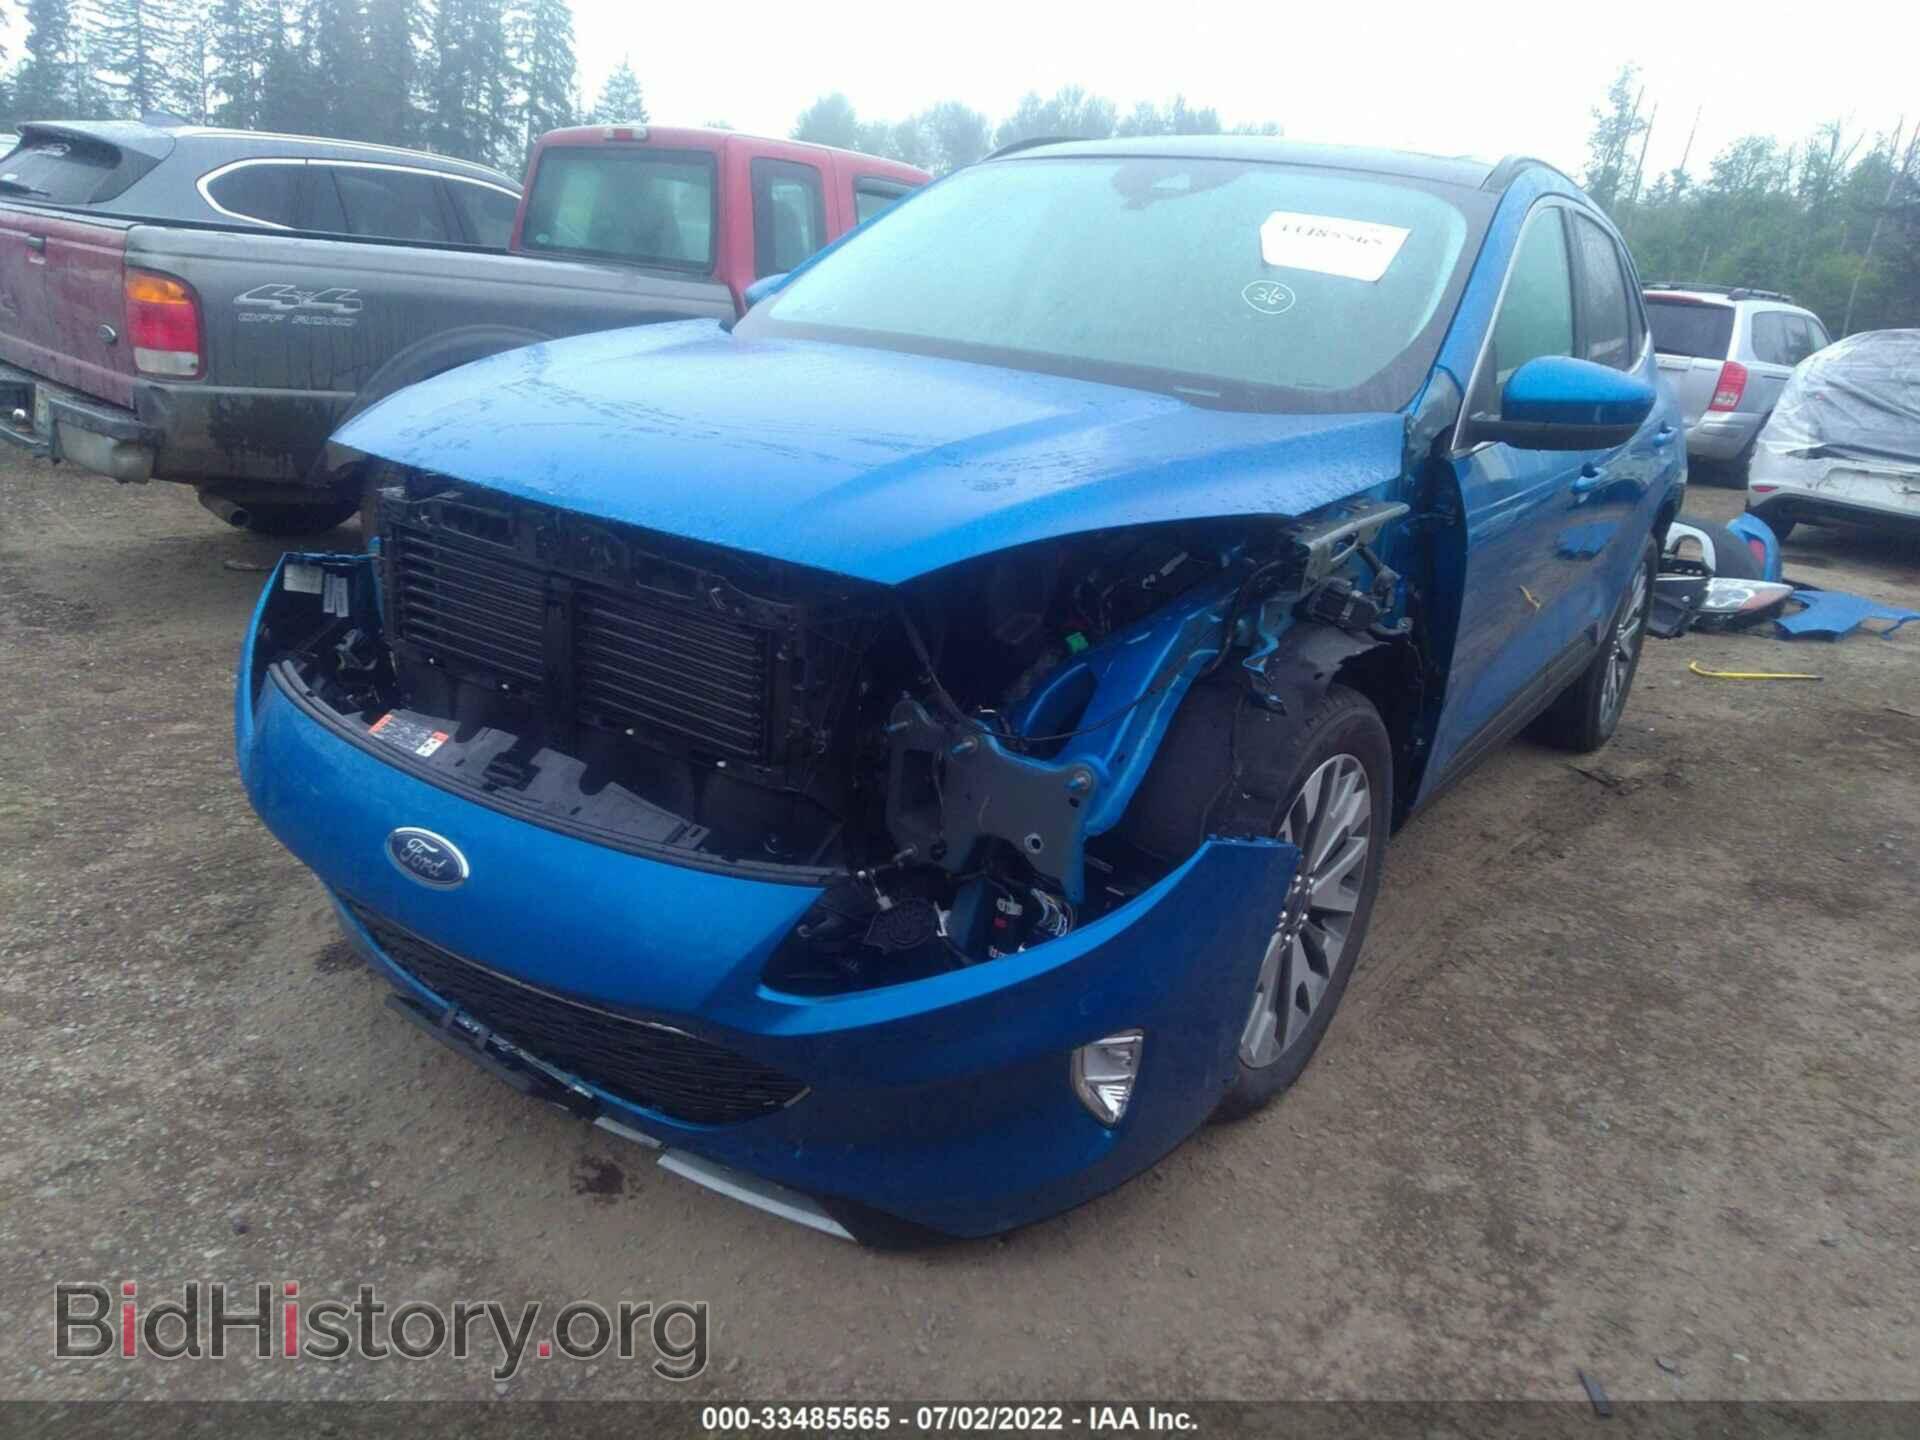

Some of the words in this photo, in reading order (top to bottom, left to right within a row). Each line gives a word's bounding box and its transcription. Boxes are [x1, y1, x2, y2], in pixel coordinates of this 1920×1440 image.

[238, 312, 286, 322] OFF
[291, 314, 356, 326] ROAD
[399, 837, 447, 877] Ford
